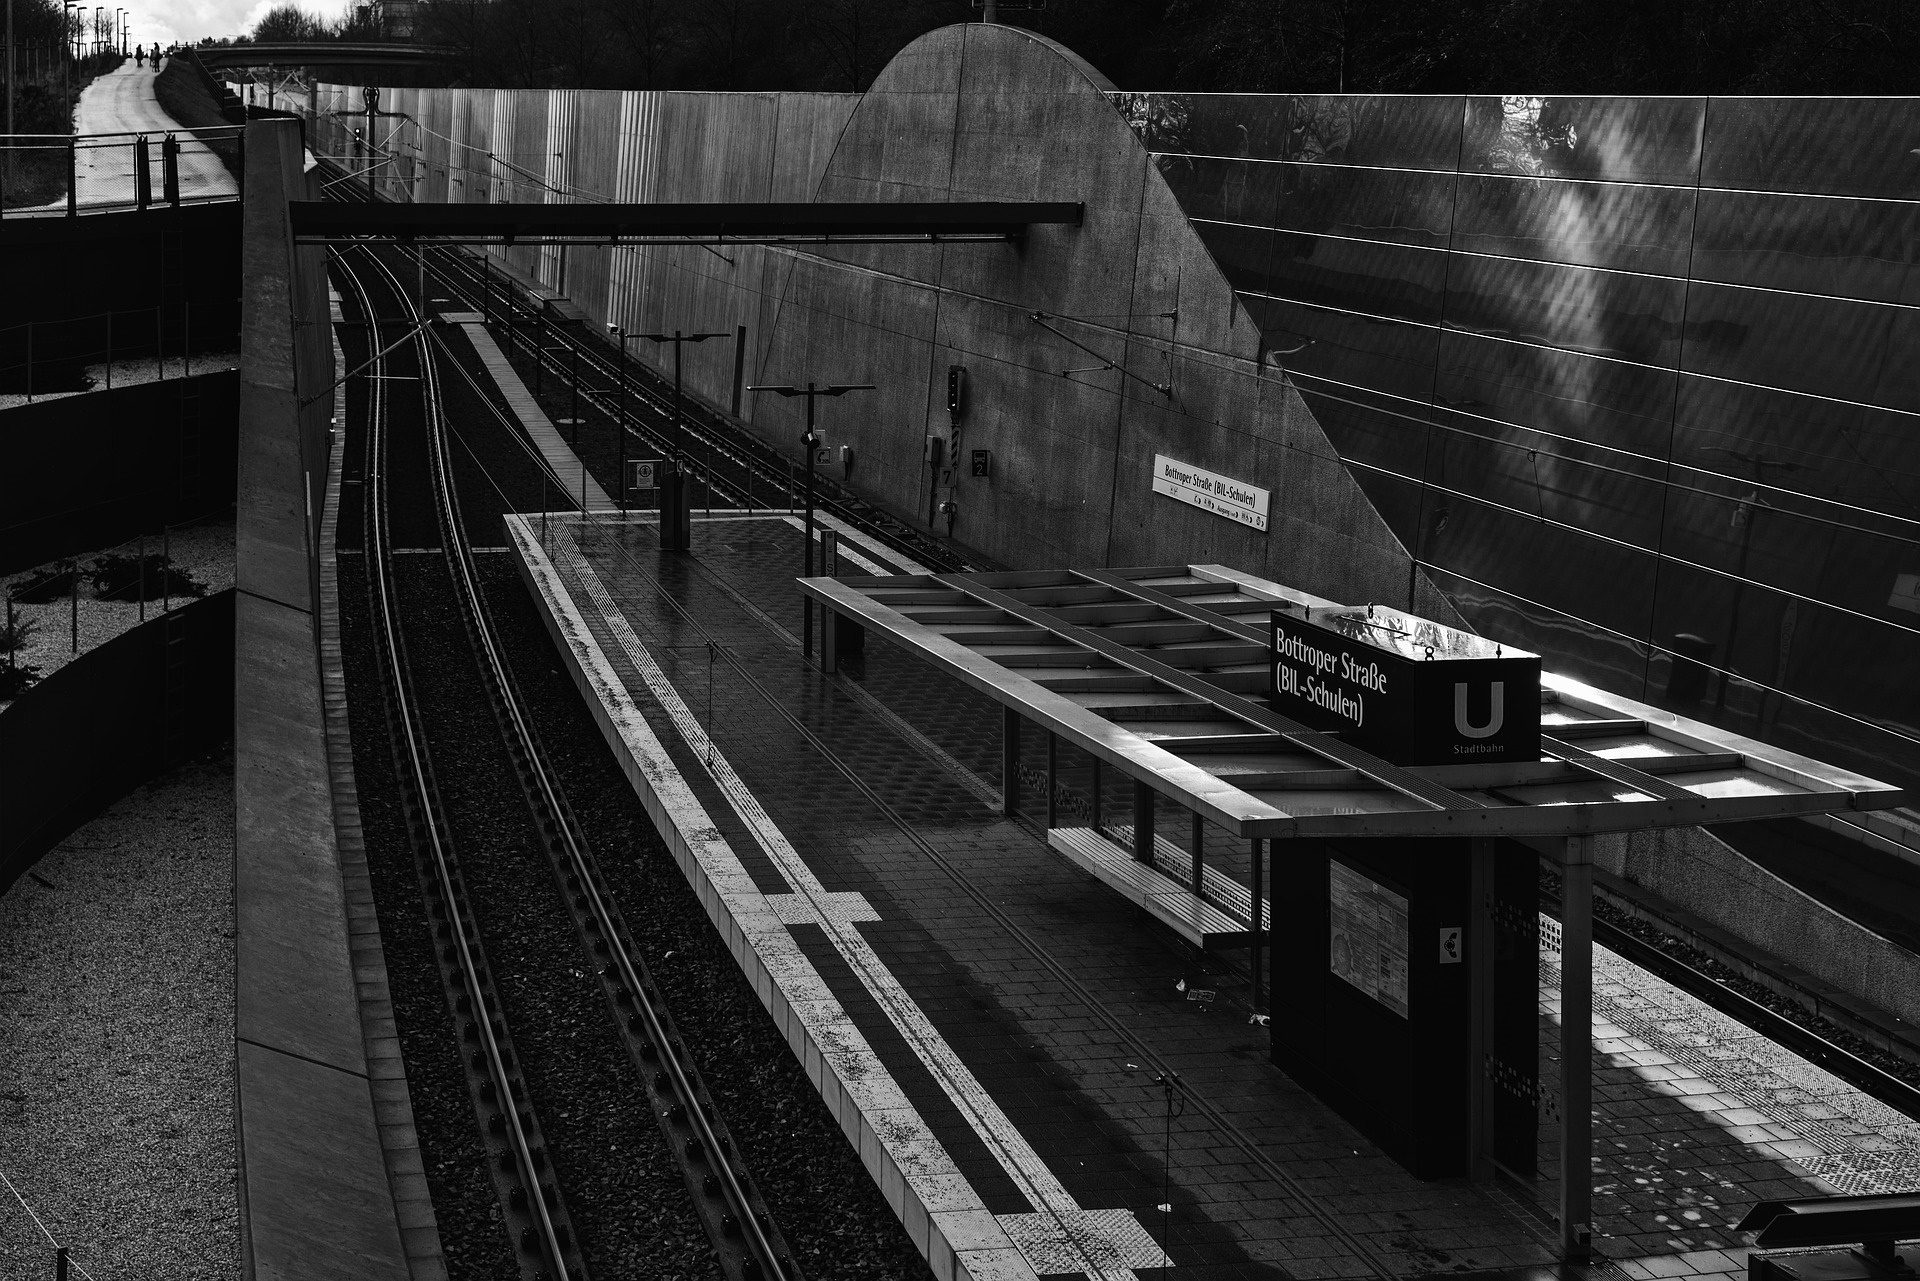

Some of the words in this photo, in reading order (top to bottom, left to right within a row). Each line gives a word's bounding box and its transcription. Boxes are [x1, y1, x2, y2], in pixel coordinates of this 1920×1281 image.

[943, 470, 951, 484] 7
[976, 464, 983, 475] 2
[1165, 464, 1192, 485] Bottroper
[1193, 474, 1212, 492] Straße
[1214, 480, 1256, 508] (BIL-Schulen)
[1276, 627, 1338, 676] Bottroper
[1341, 651, 1388, 695] Straße
[1276, 661, 1364, 728] (BIL-Schulen)
[1454, 681, 1504, 739] U
[1453, 744, 1505, 755] Stadtbahn
